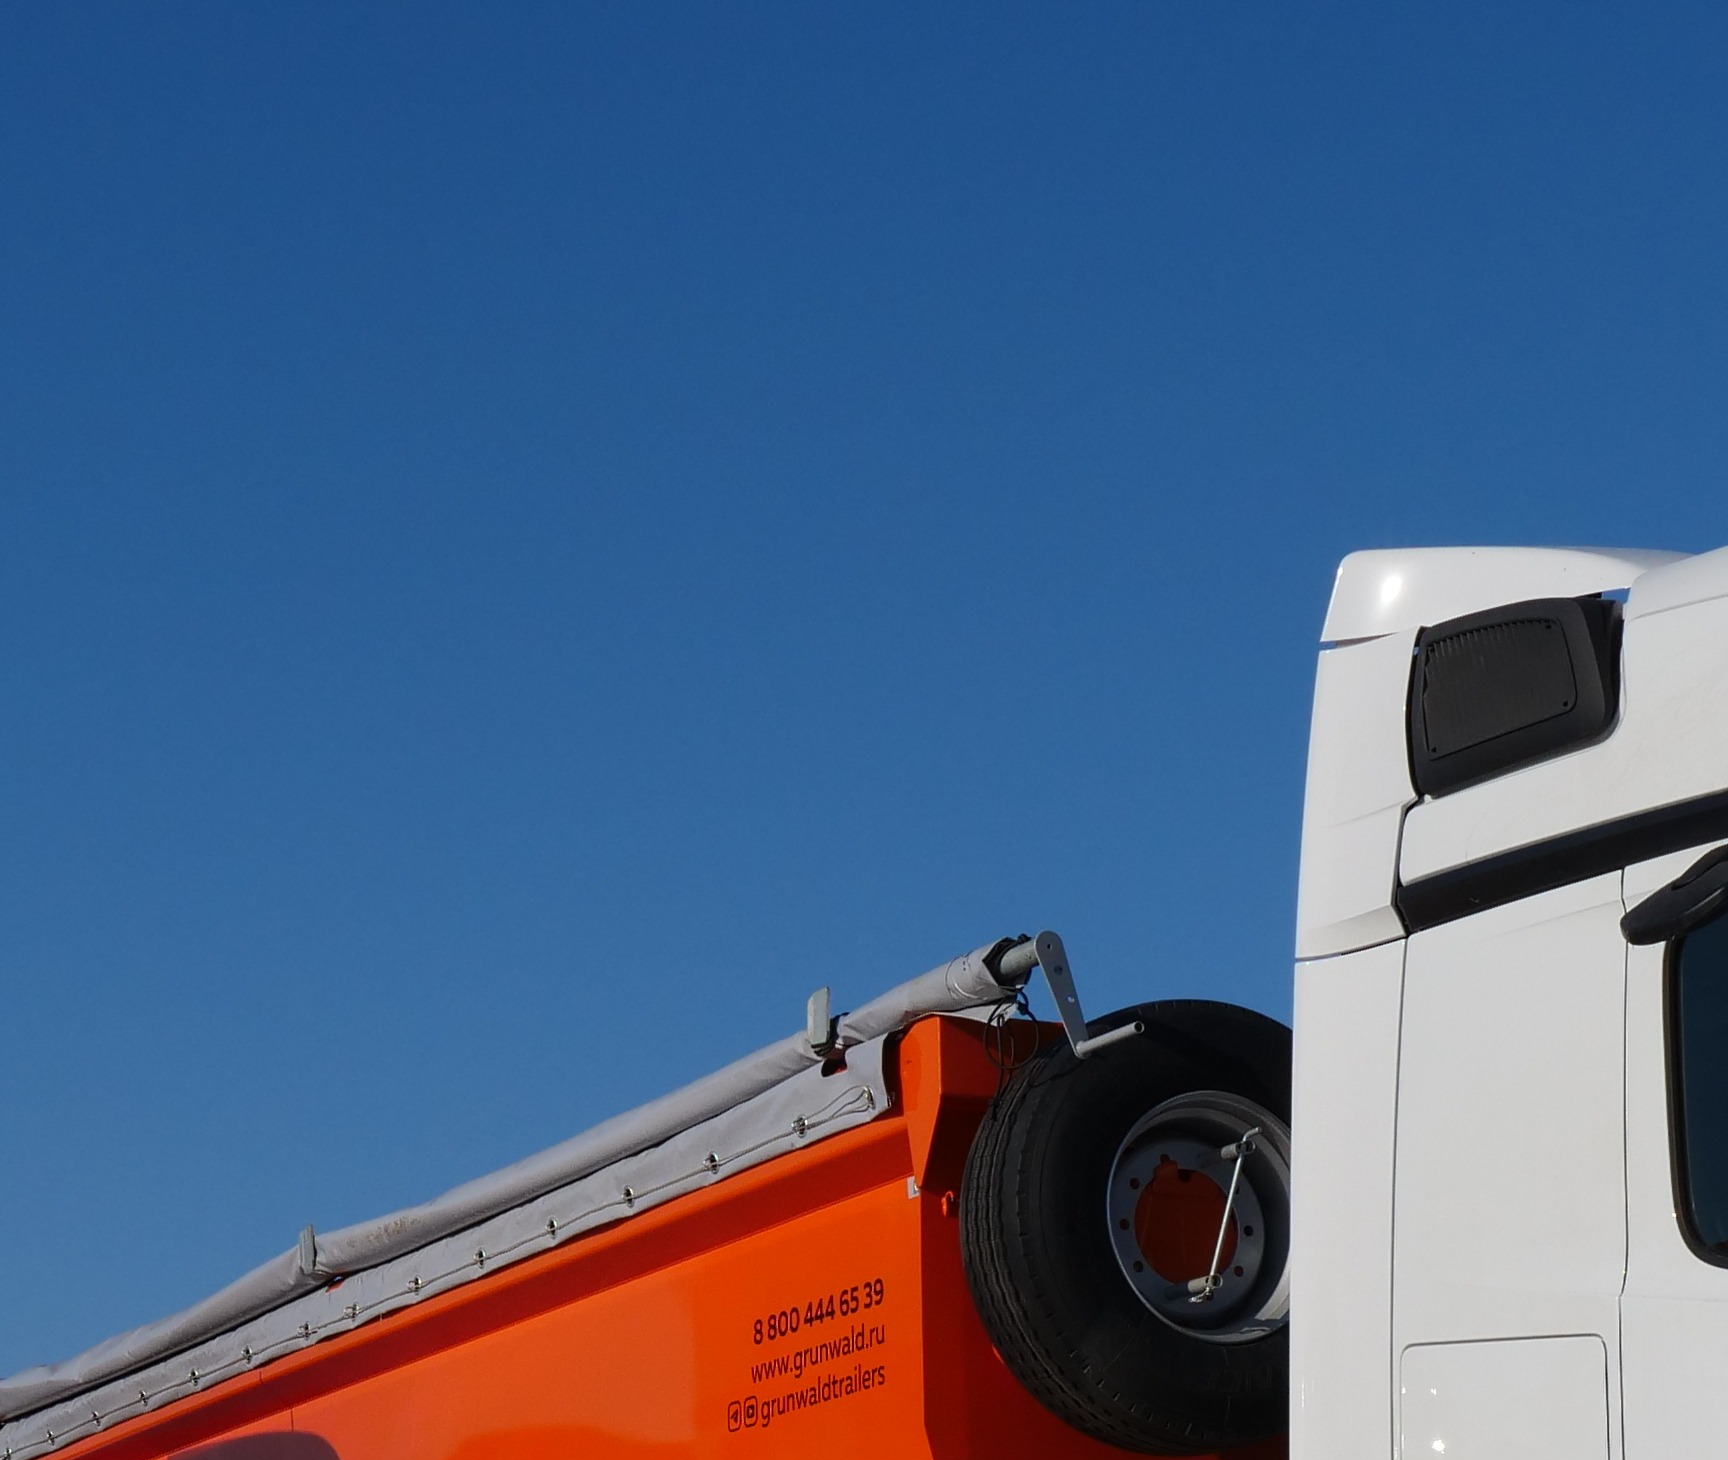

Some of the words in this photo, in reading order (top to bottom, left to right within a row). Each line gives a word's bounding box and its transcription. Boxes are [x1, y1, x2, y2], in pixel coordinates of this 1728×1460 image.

[753, 1319, 764, 1345] 8
[767, 1307, 800, 1341] 800
[804, 1294, 835, 1327] 444
[839, 1285, 860, 1317] 65
[863, 1278, 884, 1310] 39
[751, 1322, 885, 1383] www.grunwald.ru
[761, 1363, 885, 1428] grunwaldtrailers
